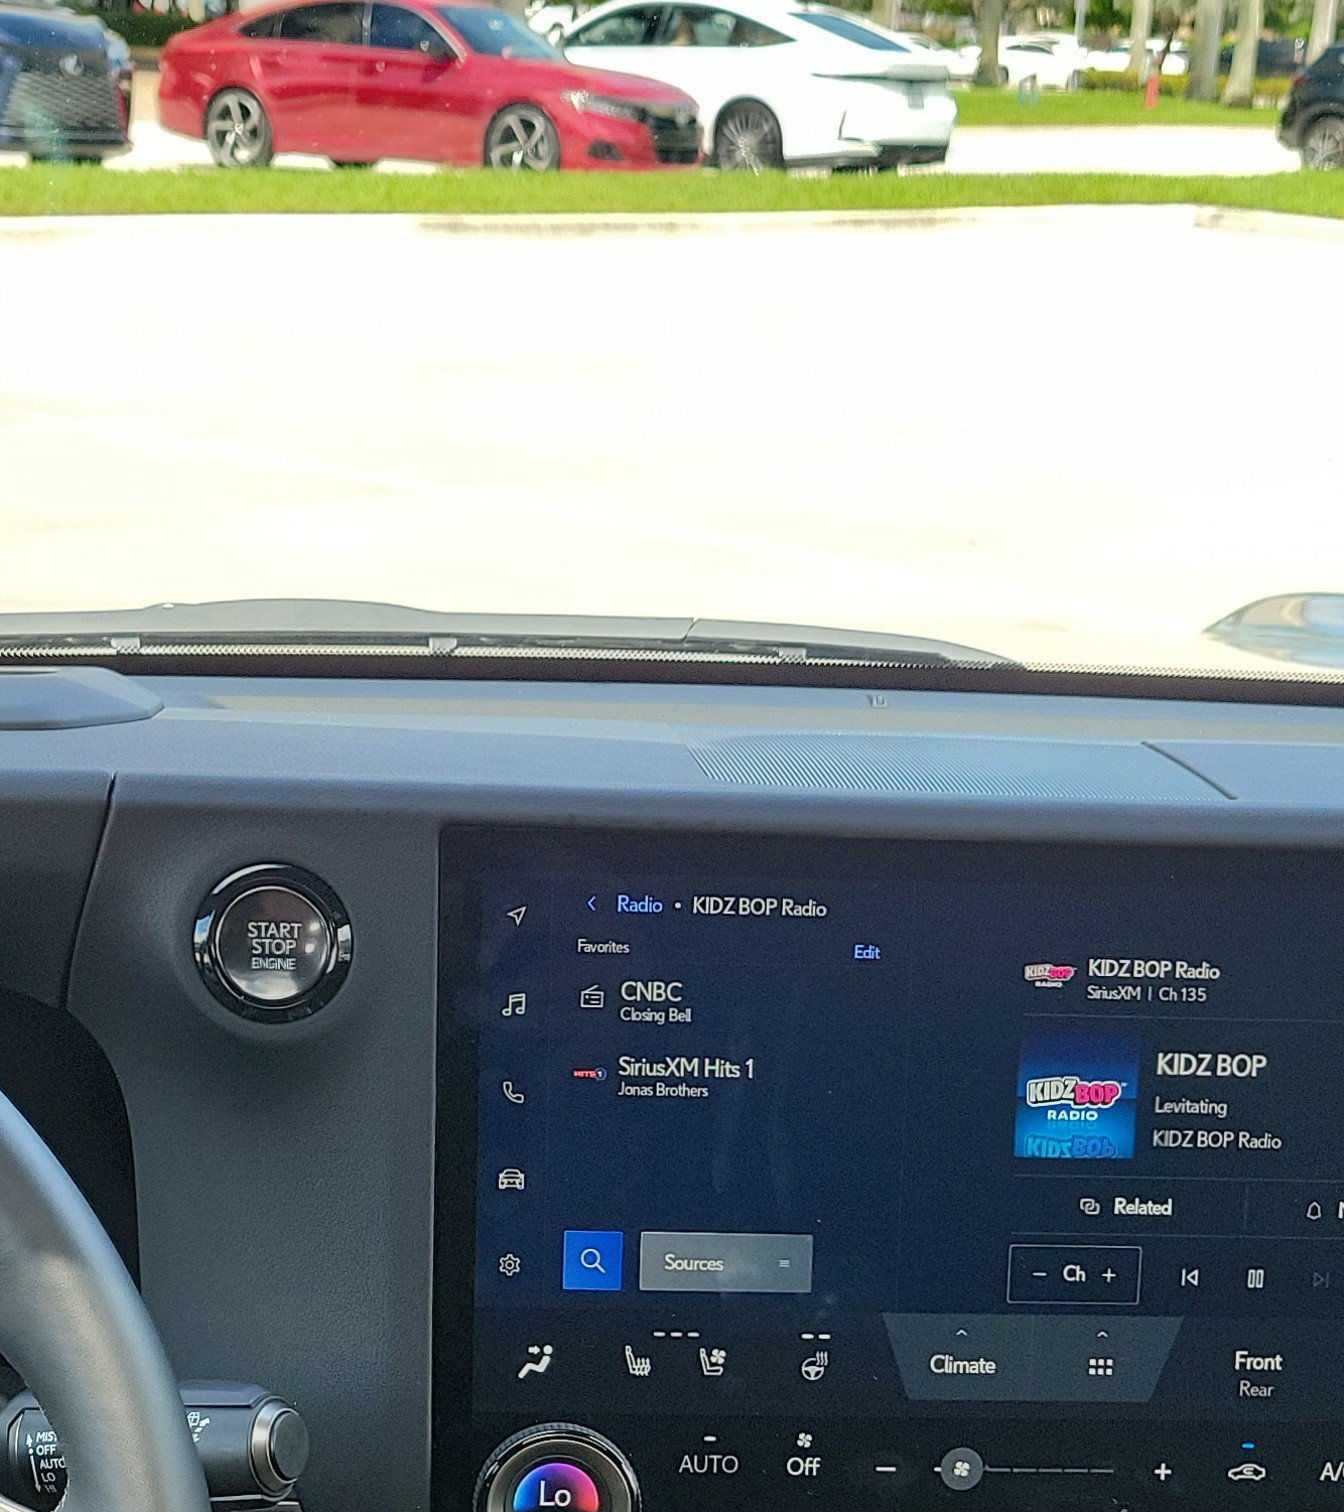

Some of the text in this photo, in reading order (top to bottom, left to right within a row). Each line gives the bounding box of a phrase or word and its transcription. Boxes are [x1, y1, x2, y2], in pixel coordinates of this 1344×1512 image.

[616, 894, 828, 918] Radio KIDZ BOP Radio
[247, 920, 303, 940] START
[251, 938, 298, 957] STOP
[576, 938, 632, 956] Favorites
[853, 942, 882, 961] Edit
[251, 957, 297, 971] ENGINE
[1087, 957, 1222, 984] KIDZ BOP Radio
[619, 980, 683, 1004] CNBC
[1086, 984, 1208, 1003] SiriusXM Ch 135
[619, 1006, 693, 1026] Closing Bell
[617, 1055, 755, 1081] SiriusXM Hits 1
[1156, 1053, 1268, 1079] KIDZ BOP
[617, 1081, 709, 1100] Jonas Brothers
[1027, 1077, 1121, 1106] KIDZ BOP
[1047, 1109, 1099, 1122] RADIO
[1154, 1096, 1228, 1119] Levitating
[1152, 1129, 1282, 1152] KIDZ BOP Radio
[1113, 1196, 1173, 1218] Related
[664, 1253, 724, 1273] Sources
[1063, 1264, 1087, 1284] Ch
[929, 1354, 997, 1374] Climate
[1233, 1350, 1284, 1371] Front
[1238, 1380, 1275, 1398] Rear
[36, 1445, 57, 1457] OFF
[678, 1454, 739, 1475] AUTO
[786, 1456, 820, 1477] Off
[538, 1479, 572, 1508] Lo
